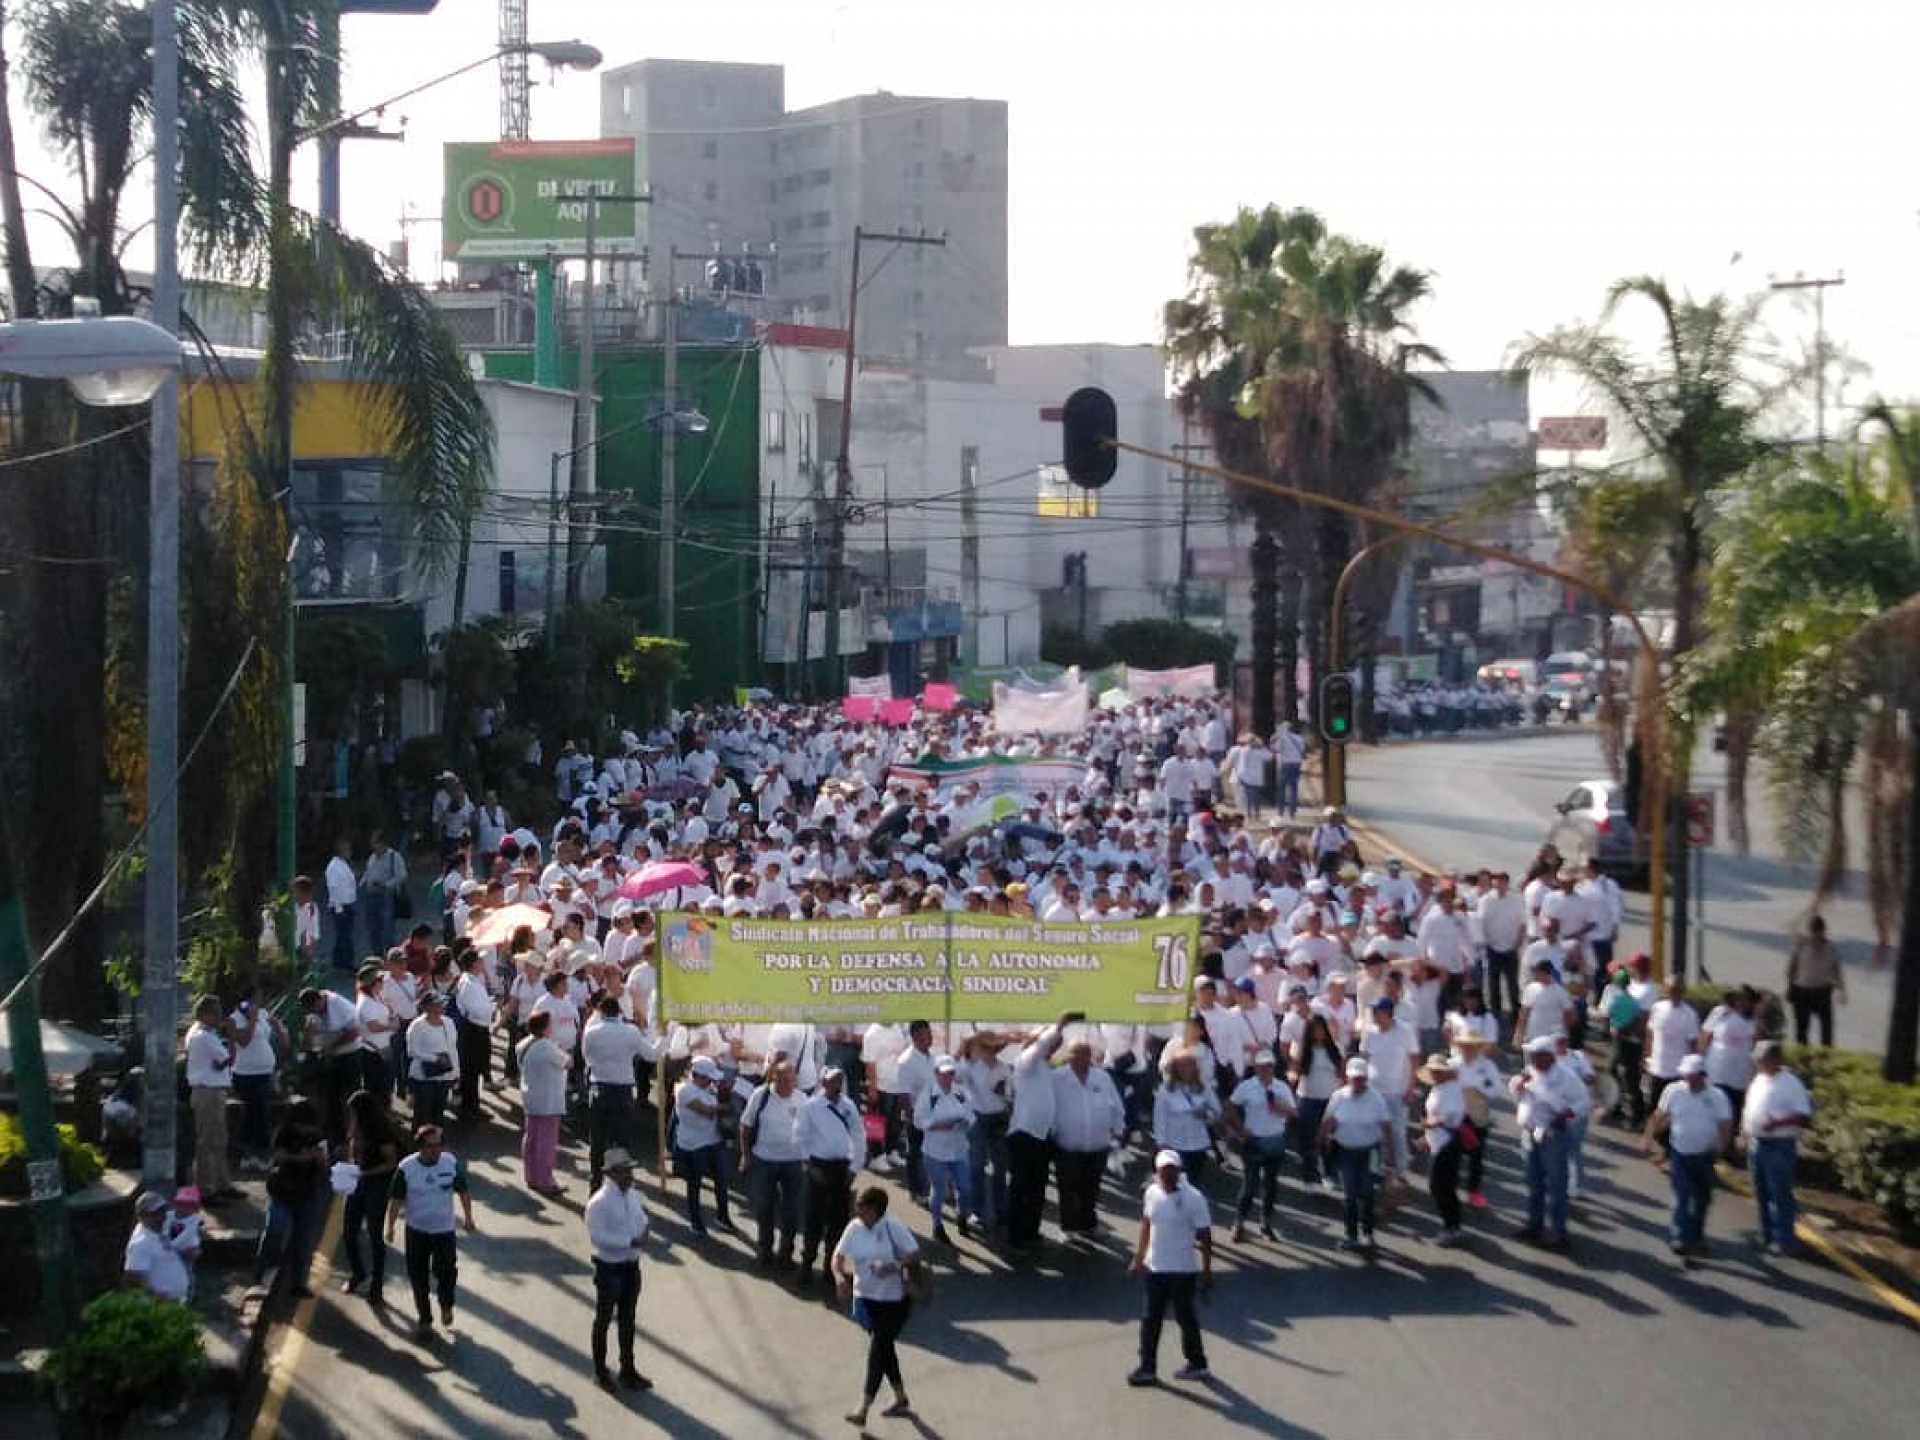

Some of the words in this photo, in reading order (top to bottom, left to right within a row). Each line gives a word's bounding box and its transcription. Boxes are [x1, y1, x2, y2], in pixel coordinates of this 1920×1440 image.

[731, 921, 804, 941] Sindicato
[808, 926, 875, 942] Nacional
[807, 952, 830, 969] LA
[841, 952, 926, 969] DEFENSA
[935, 952, 948, 969] A
[957, 952, 980, 969] LA
[1153, 933, 1188, 990] 76
[807, 976, 823, 993] Y
[831, 976, 954, 994] DEMOCRACIA
